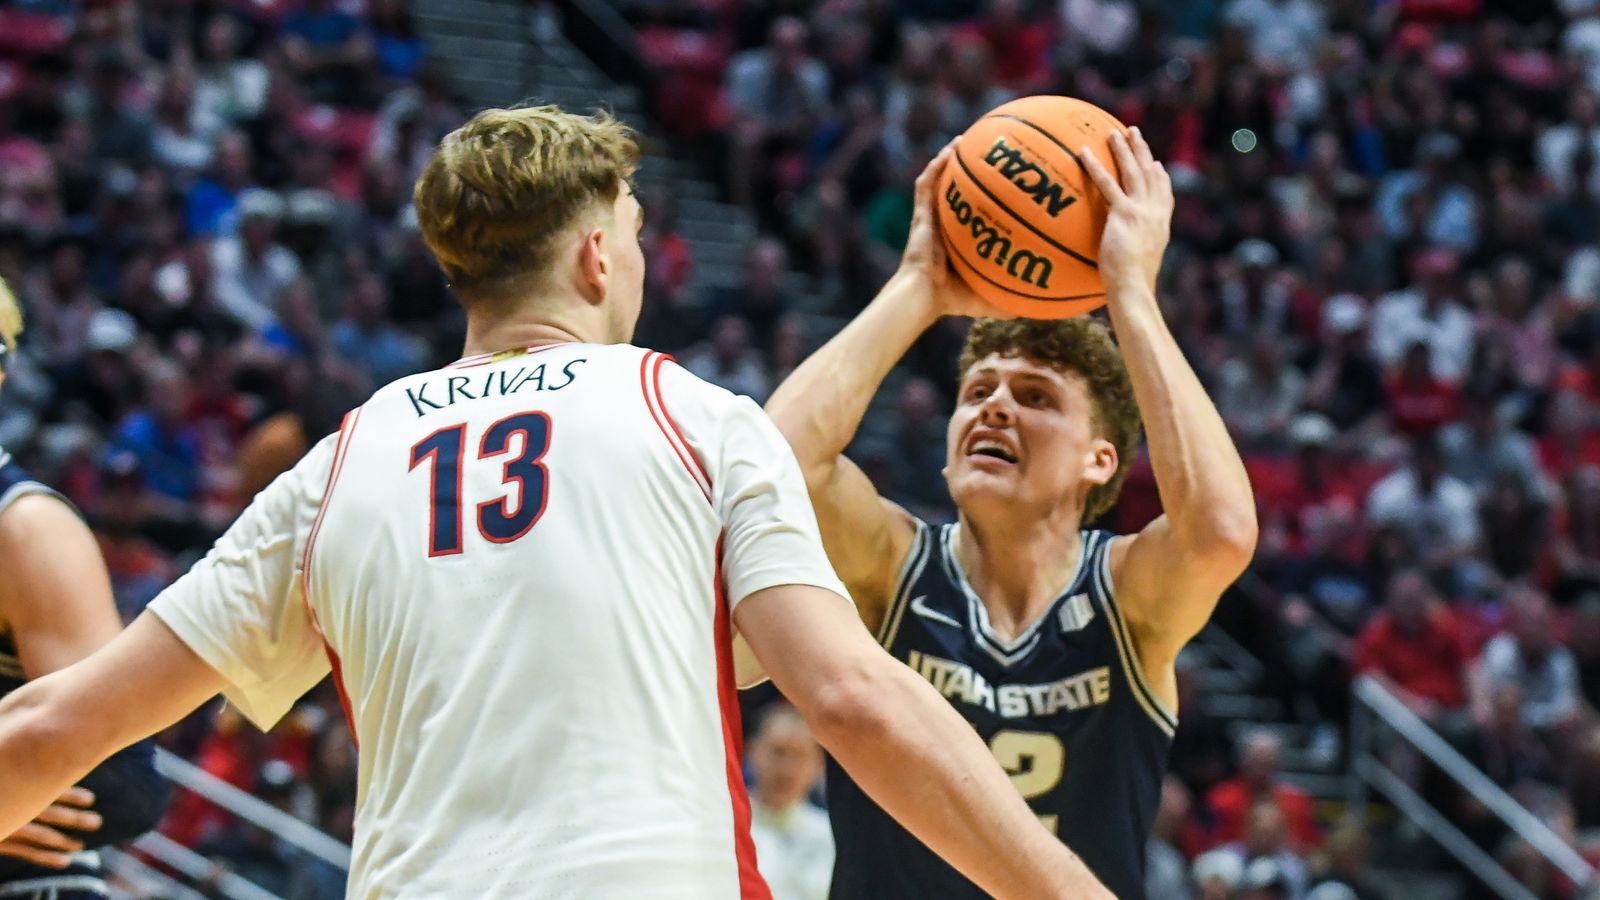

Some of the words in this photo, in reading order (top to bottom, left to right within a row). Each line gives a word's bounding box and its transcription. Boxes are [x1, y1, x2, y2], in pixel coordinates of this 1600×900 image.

[984, 138, 1076, 217] NCAA
[946, 178, 1053, 289] Wilson
[405, 358, 588, 418] KRIVAS
[408, 410, 552, 558] 13
[997, 666, 1111, 718] STATE
[972, 724, 1066, 837] 2
